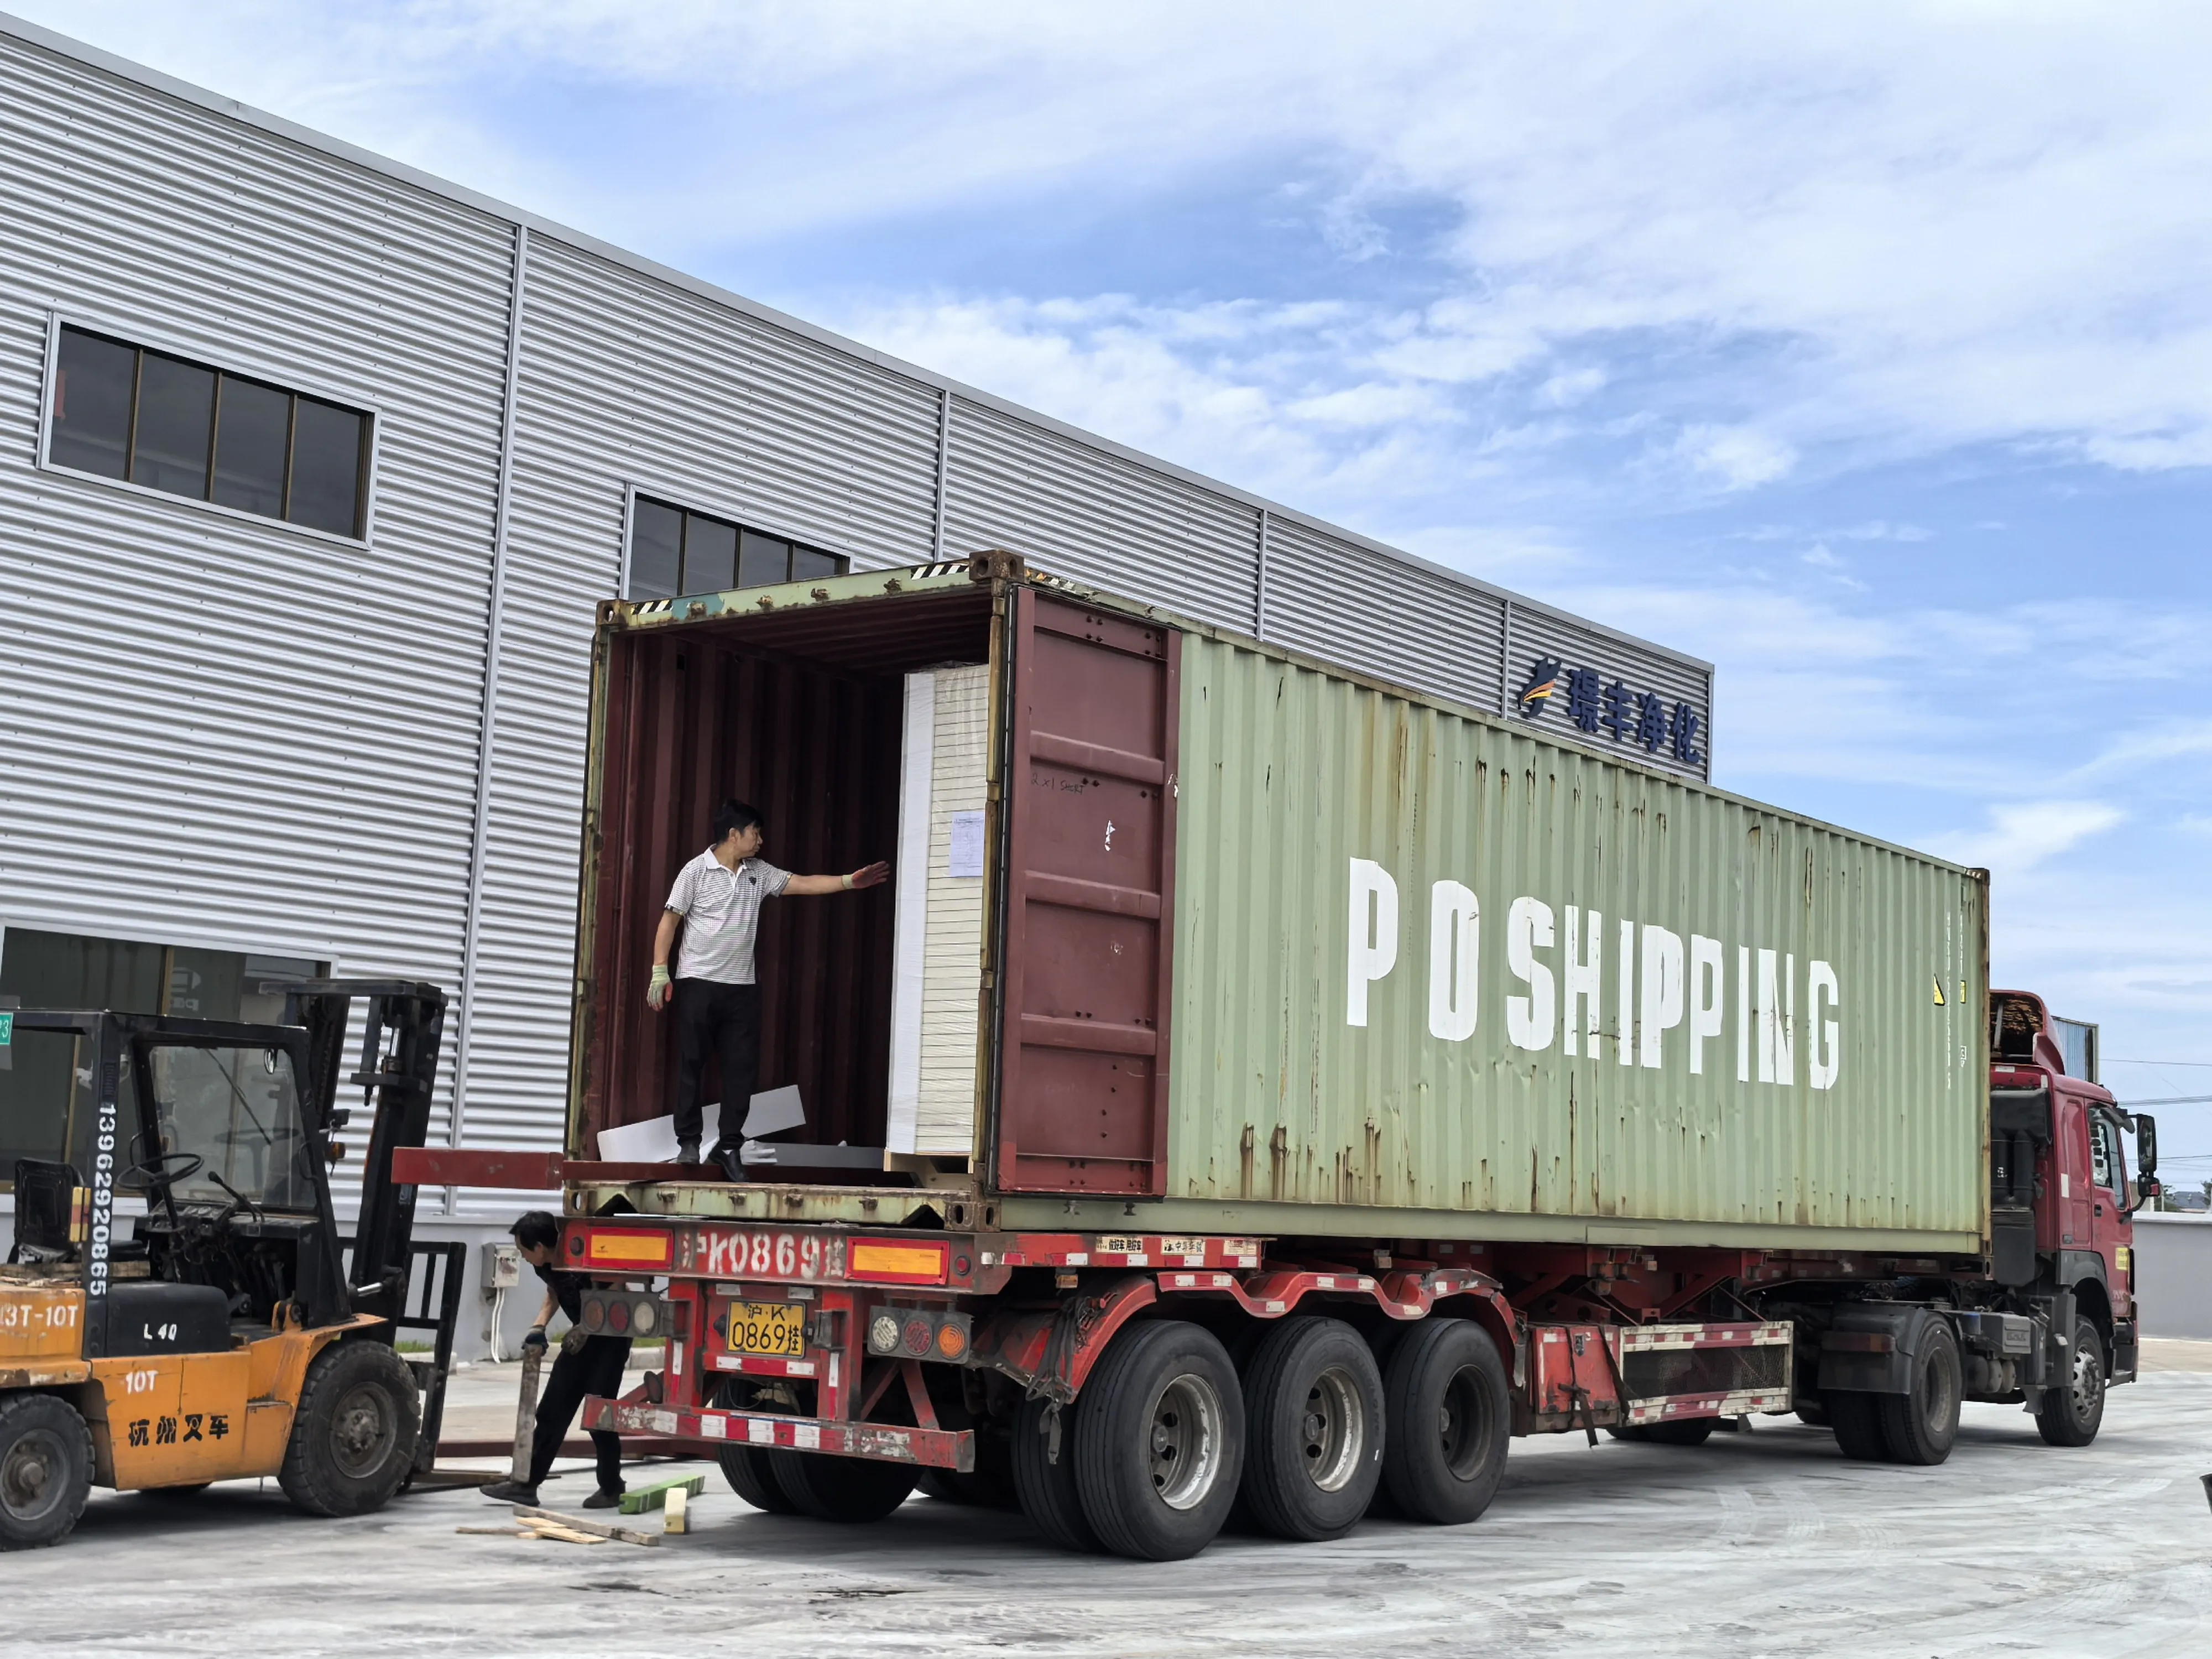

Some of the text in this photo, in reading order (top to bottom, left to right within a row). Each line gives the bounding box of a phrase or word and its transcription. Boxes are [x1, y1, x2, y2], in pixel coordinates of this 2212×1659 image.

[1506, 896, 1839, 1090] SHIPPING
[90, 1104, 117, 1296] 13962920865
[0, 1303, 79, 1327] 3T-10T
[732, 1321, 800, 1354] 0869挂
[126, 1370, 159, 1395] 10T
[128, 1413, 229, 1447] 杭州叉车
